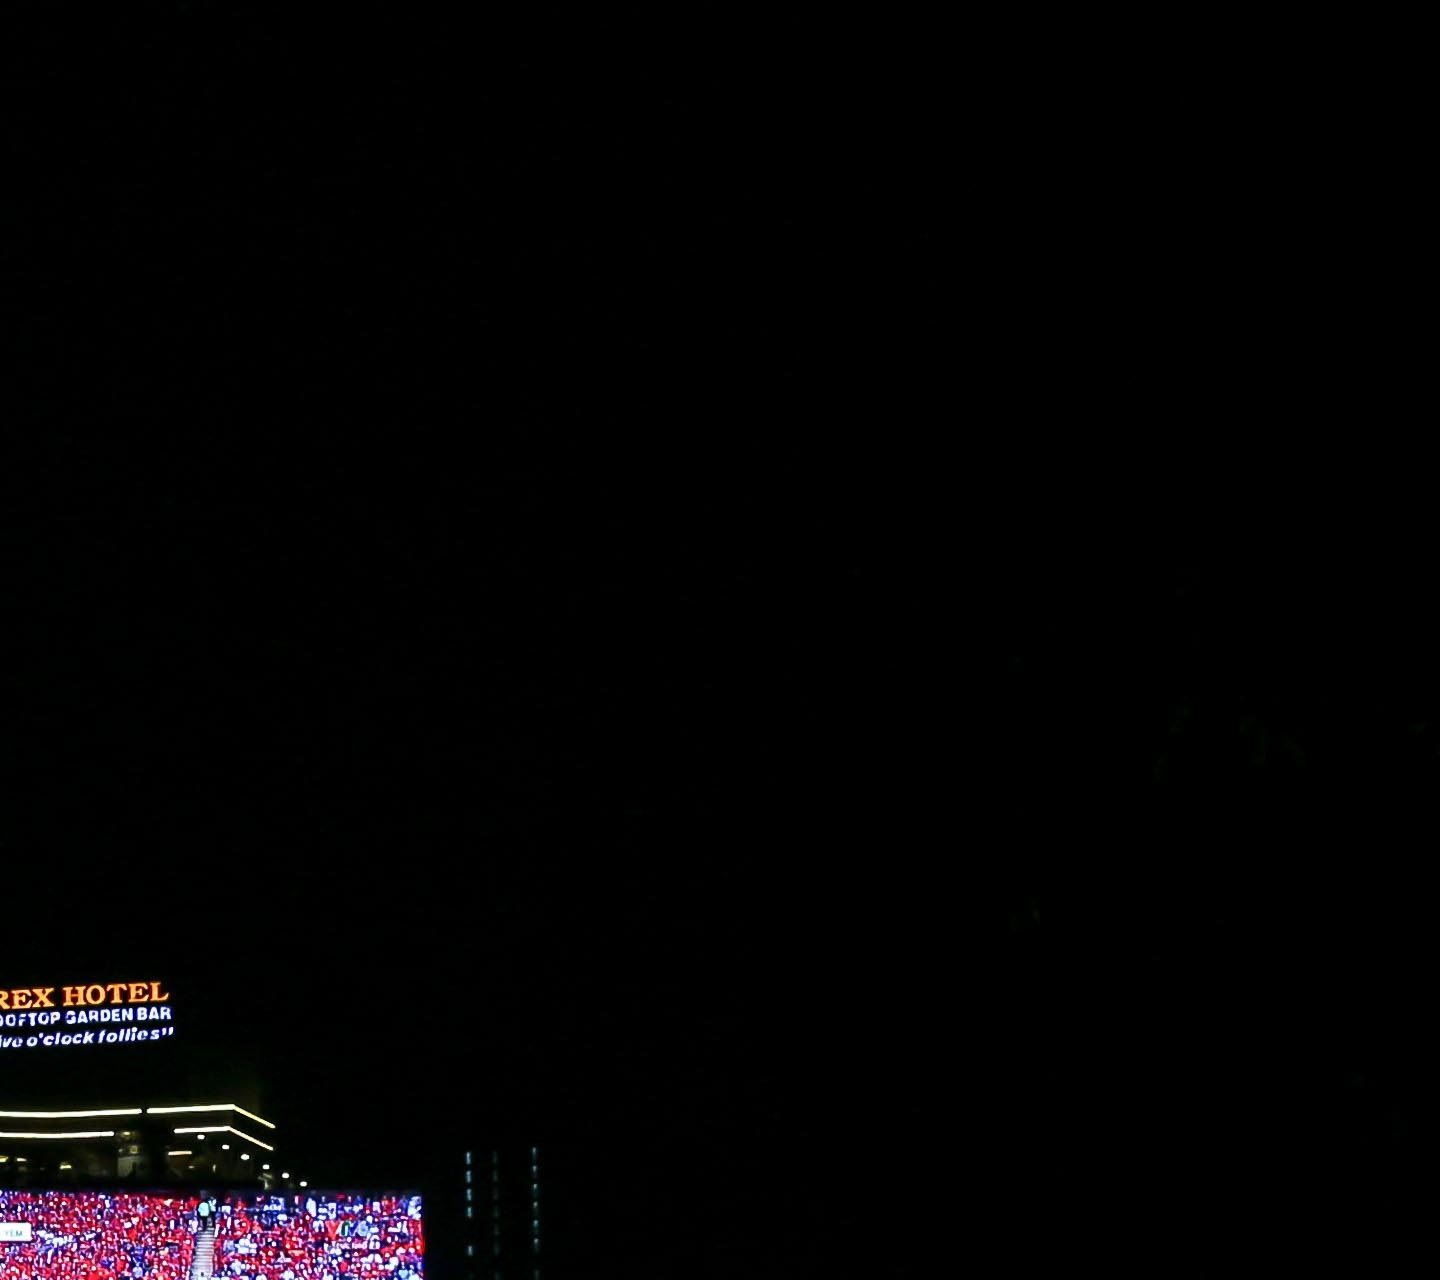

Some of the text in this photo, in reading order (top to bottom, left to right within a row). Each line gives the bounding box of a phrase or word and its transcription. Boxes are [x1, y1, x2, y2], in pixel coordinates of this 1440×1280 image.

[62, 981, 170, 1007] HOTEL
[64, 1007, 134, 1025] GARDEN
[136, 1006, 172, 1021] BAR
